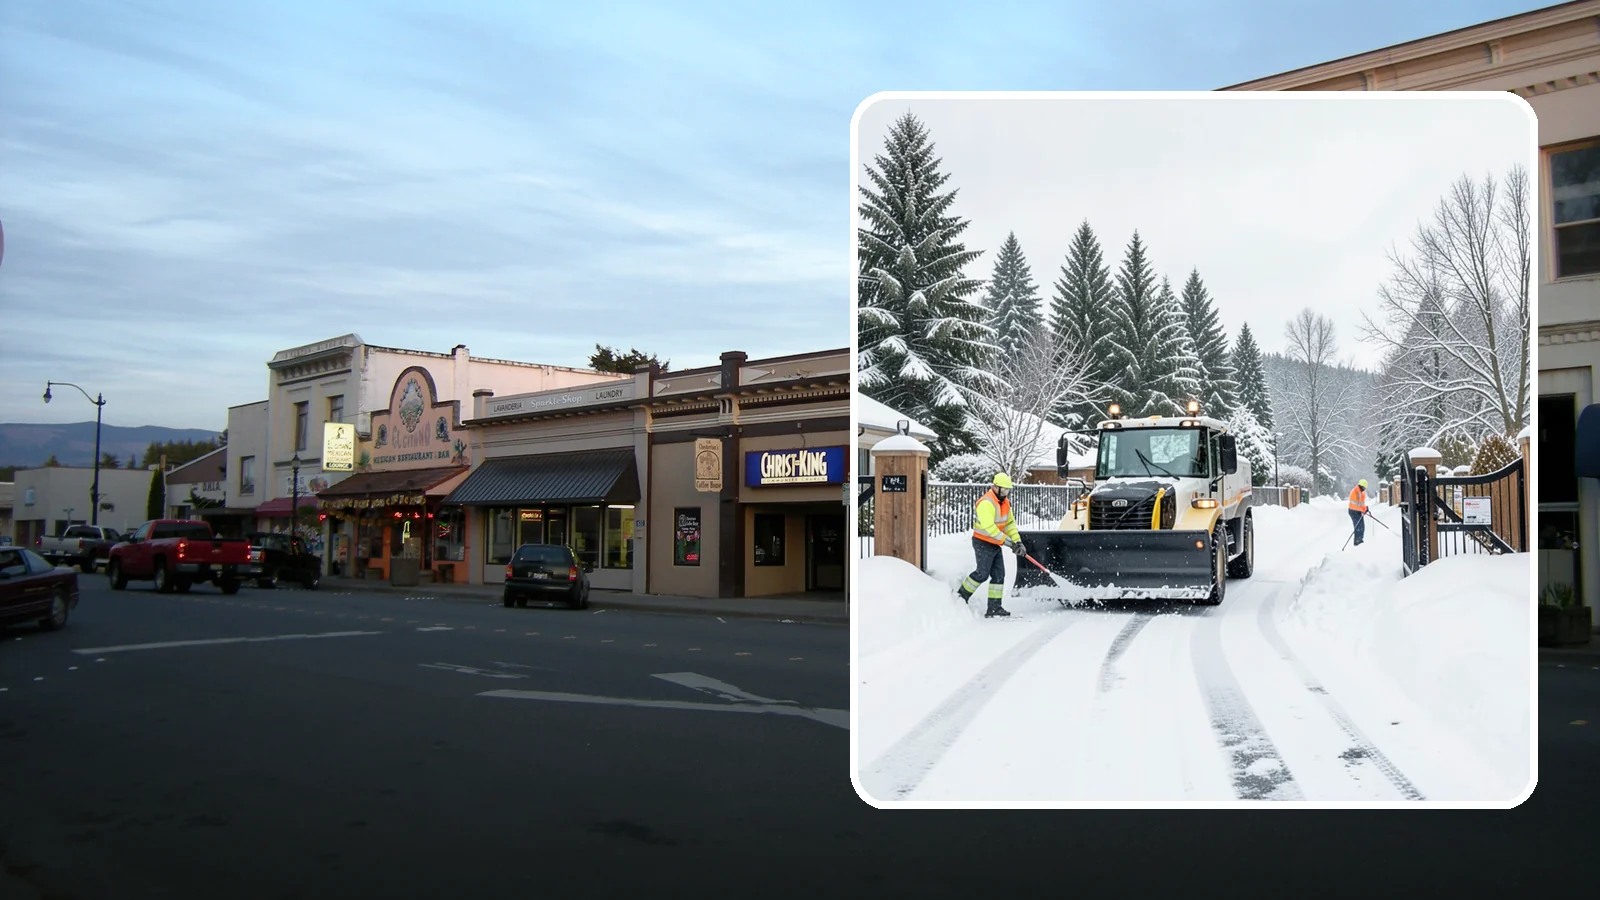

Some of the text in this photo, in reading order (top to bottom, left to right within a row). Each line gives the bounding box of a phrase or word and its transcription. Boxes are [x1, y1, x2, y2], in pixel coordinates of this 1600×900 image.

[596, 389, 623, 400] LAUNDRY
[493, 402, 522, 412] LAVANDERIA
[531, 394, 582, 408] Sparkle Shop
[373, 450, 450, 464] MEXICAN RESTAURANT BAR
[761, 450, 827, 478] CHRIST KING
[696, 481, 722, 489] Coffee House
